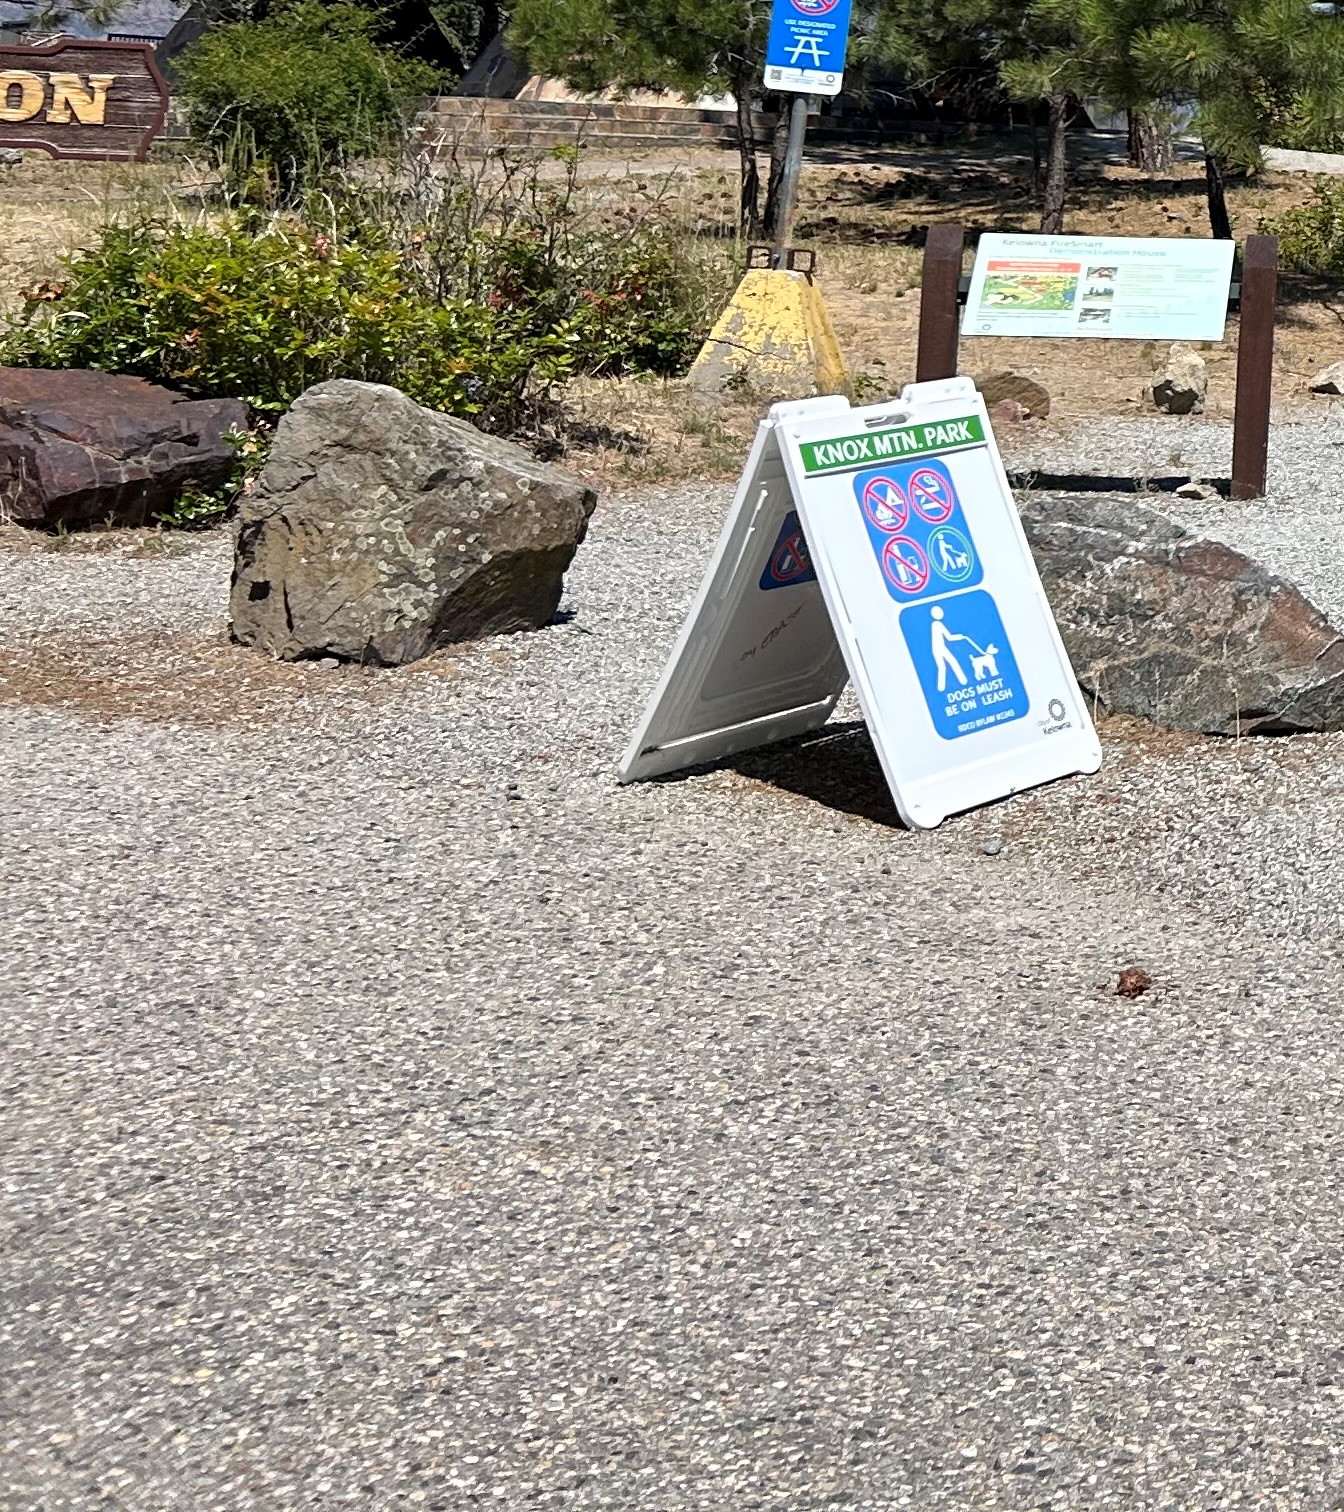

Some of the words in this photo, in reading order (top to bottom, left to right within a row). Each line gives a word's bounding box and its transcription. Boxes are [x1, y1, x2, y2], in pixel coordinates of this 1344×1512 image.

[0, 70, 116, 125] ON
[1002, 239, 1047, 247] Kelowna
[1051, 240, 1104, 248] FireSmart
[813, 438, 873, 467] KNOX
[874, 431, 924, 456] MTN.
[924, 420, 974, 447] PARK
[944, 703, 960, 717] BE
[960, 699, 978, 712] ON
[981, 688, 1014, 706] LEASH
[946, 686, 976, 704] DOGS
[976, 678, 1004, 695] MUST
